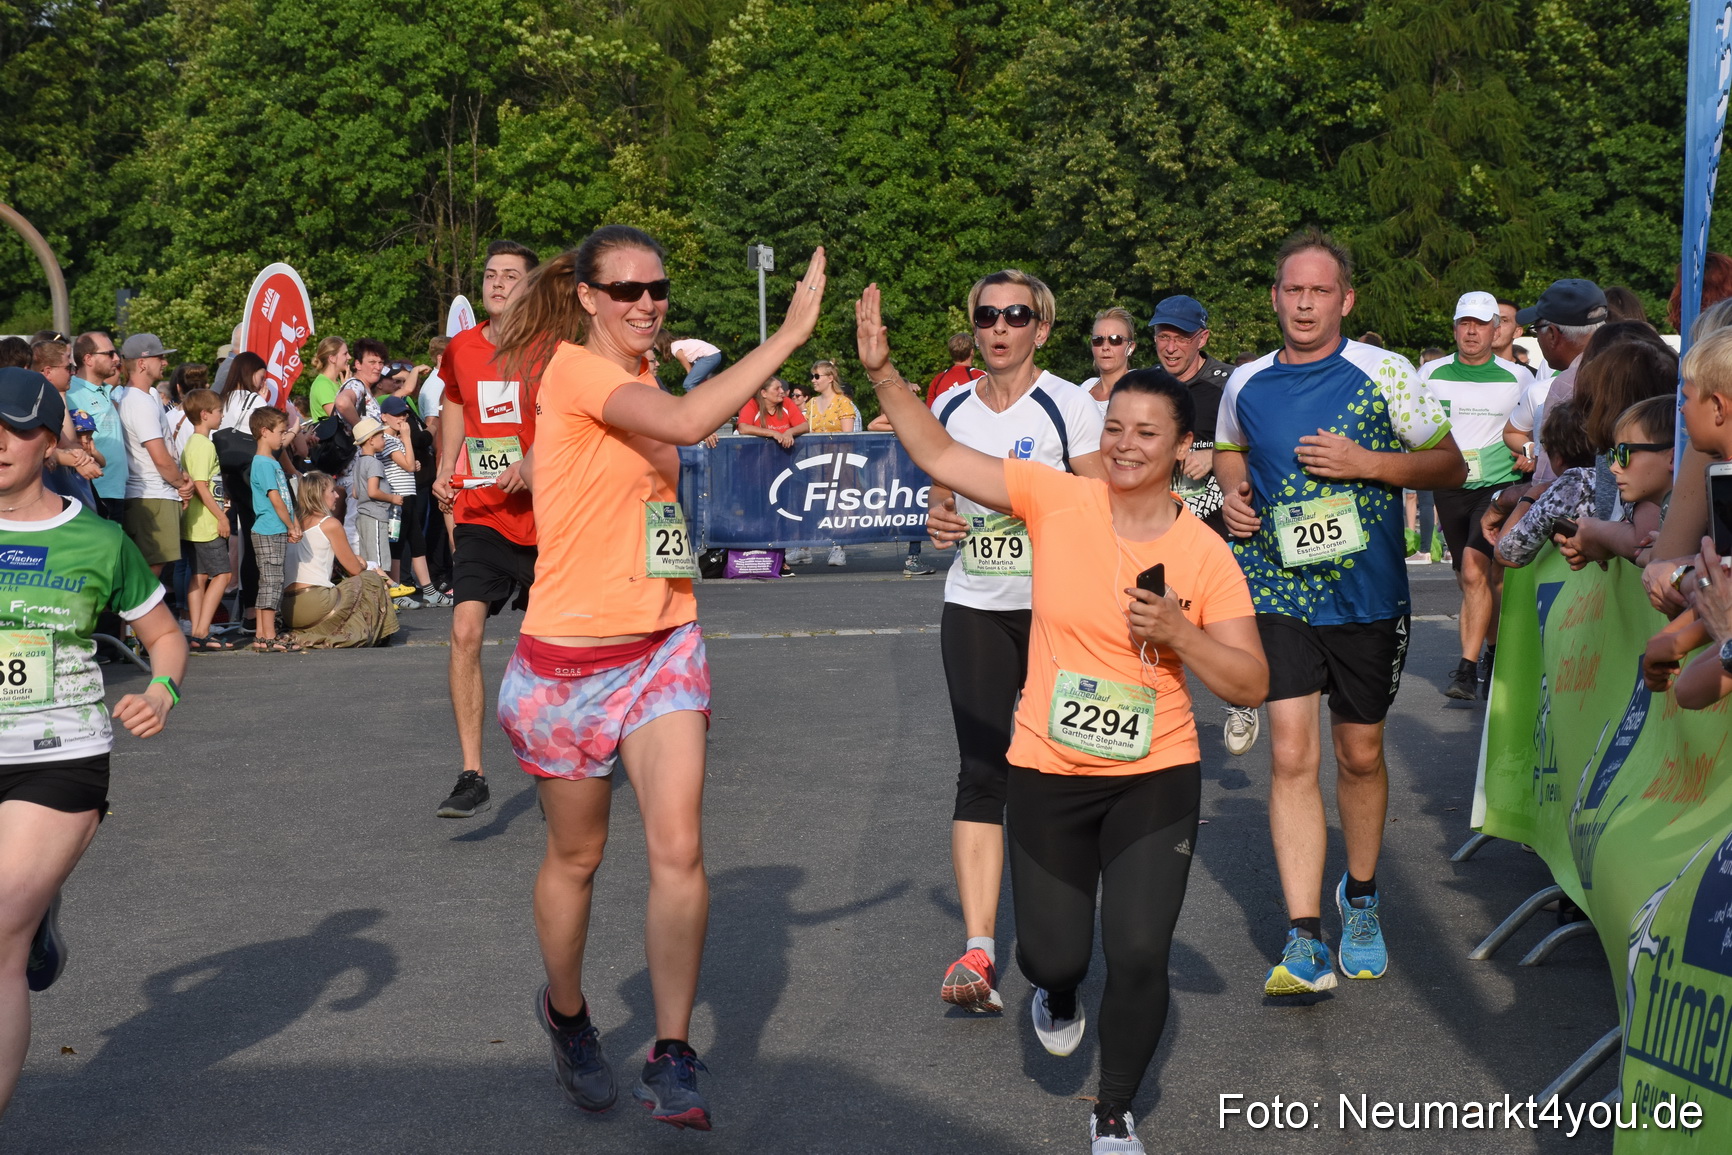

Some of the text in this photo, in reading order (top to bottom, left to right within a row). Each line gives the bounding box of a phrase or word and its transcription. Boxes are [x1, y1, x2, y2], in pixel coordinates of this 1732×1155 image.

[261, 288, 276, 318] AVIA
[479, 453, 511, 470] 464
[1337, 508, 1352, 516] 2019
[1294, 518, 1342, 548] 205
[969, 536, 1023, 558] 1879
[1297, 540, 1347, 555] Essrich Torsten
[7, 552, 43, 563] Fischer
[10, 600, 70, 616] Firmen
[25, 650, 46, 658] 2019
[2, 687, 33, 695] Sandra
[1131, 706, 1150, 715] 2019
[1060, 700, 1139, 740] 2294
[1062, 727, 1134, 749] Garthoff Stephanie
[1080, 740, 1095, 748] Thule
